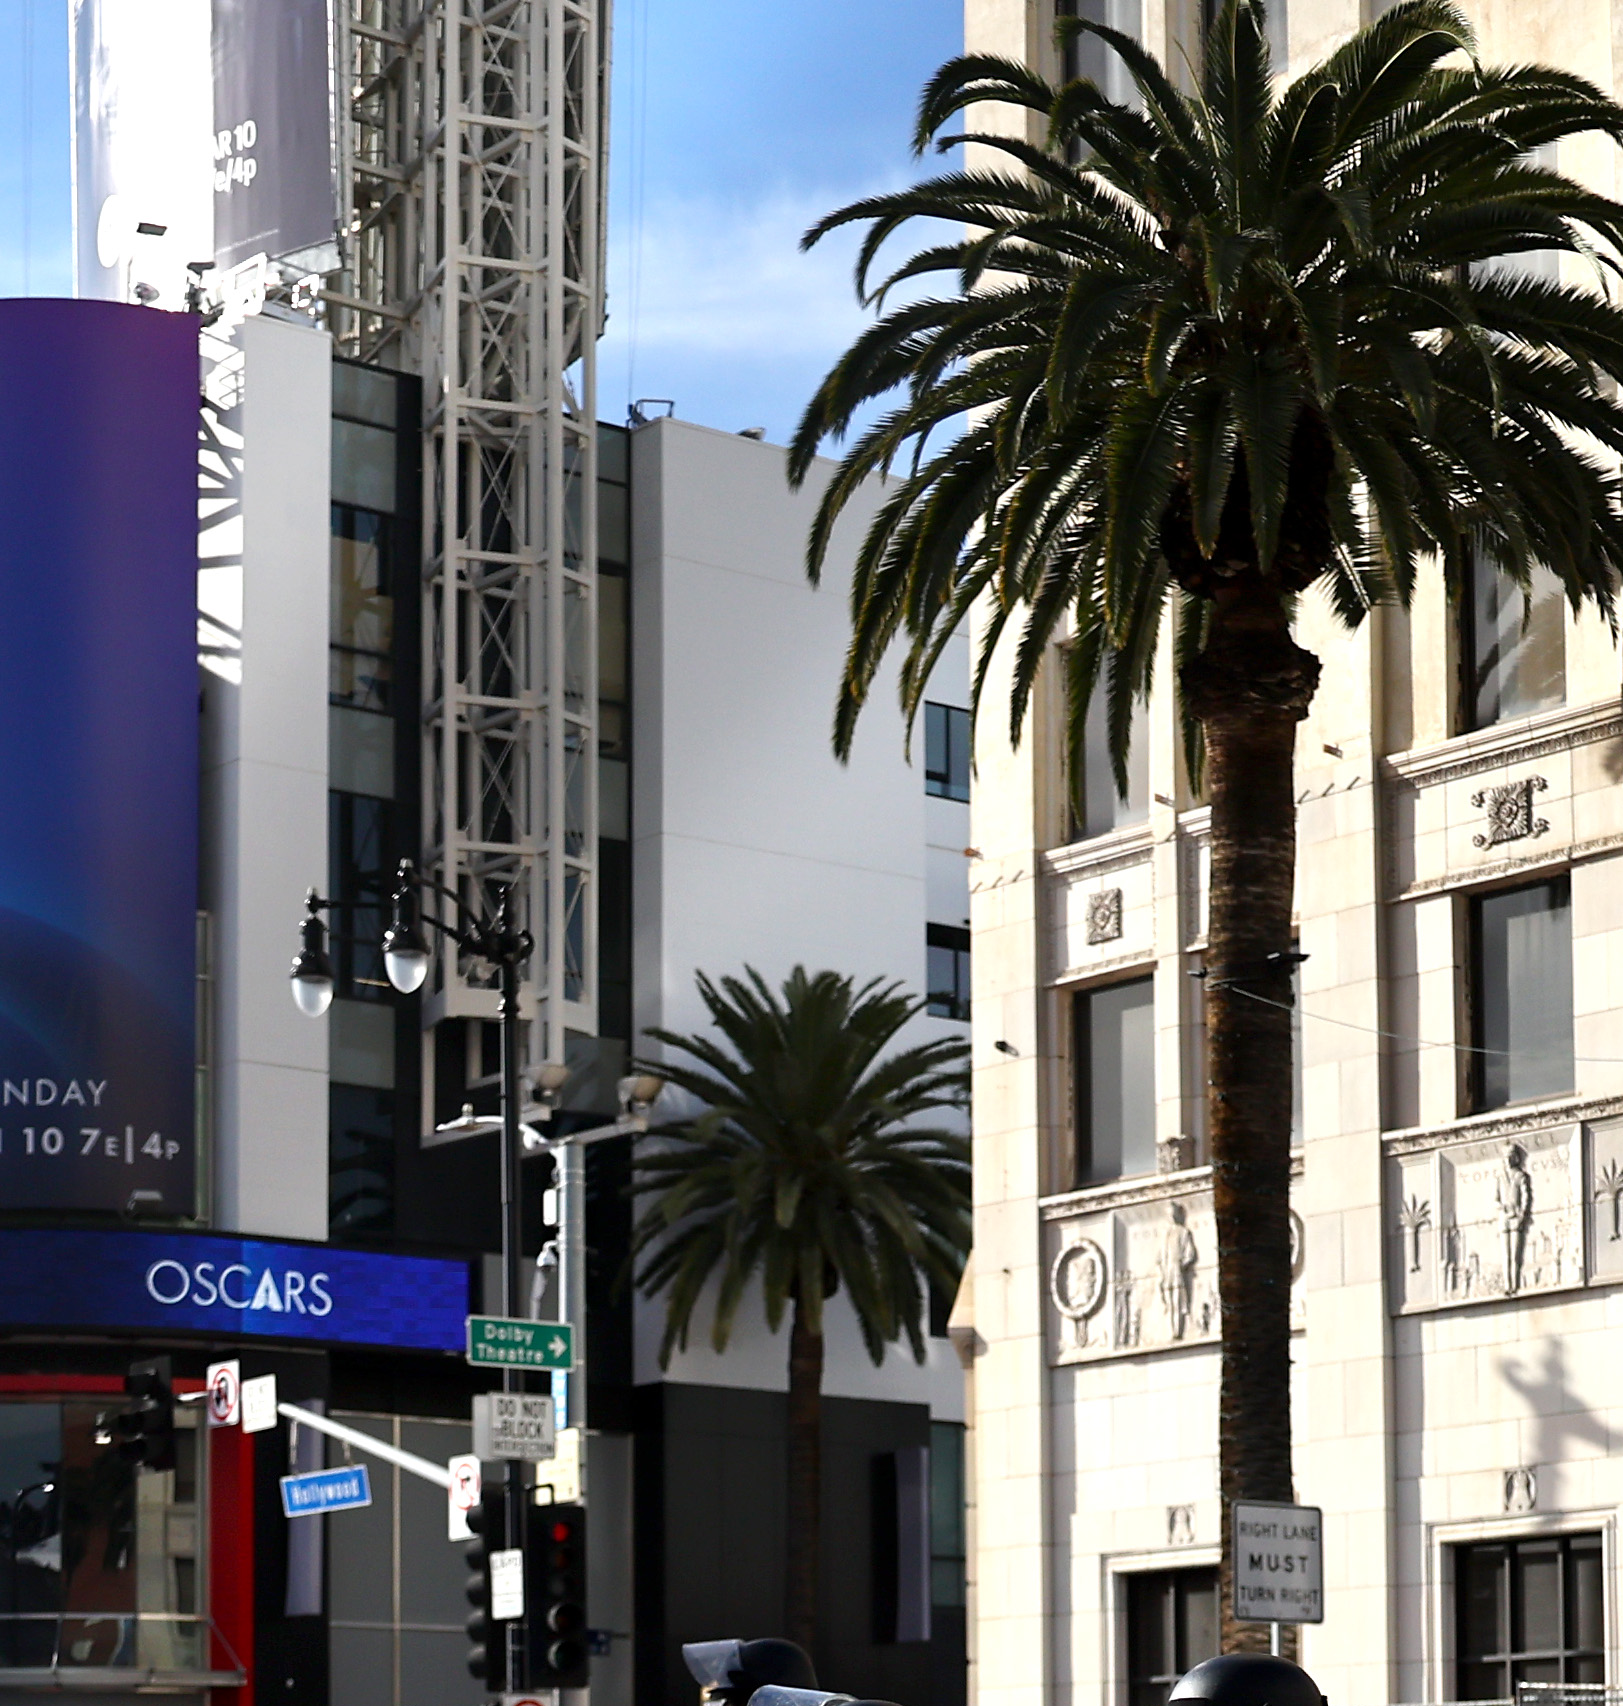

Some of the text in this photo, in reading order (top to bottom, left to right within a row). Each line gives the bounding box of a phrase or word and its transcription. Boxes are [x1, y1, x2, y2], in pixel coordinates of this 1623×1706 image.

[233, 119, 257, 152] 10
[22, 1126, 64, 1155] 10
[145, 1258, 333, 1317] OSCARS
[484, 1323, 535, 1346] Dolby
[475, 1343, 545, 1365] Theatre
[496, 1398, 548, 1419] DO NOT
[502, 1419, 544, 1439] BLOCK
[290, 1477, 360, 1507] Hollywood
[1239, 1521, 1319, 1542] RIGHT LANE
[1248, 1552, 1309, 1574] MUST
[1240, 1585, 1320, 1605] TURN RIGHT
